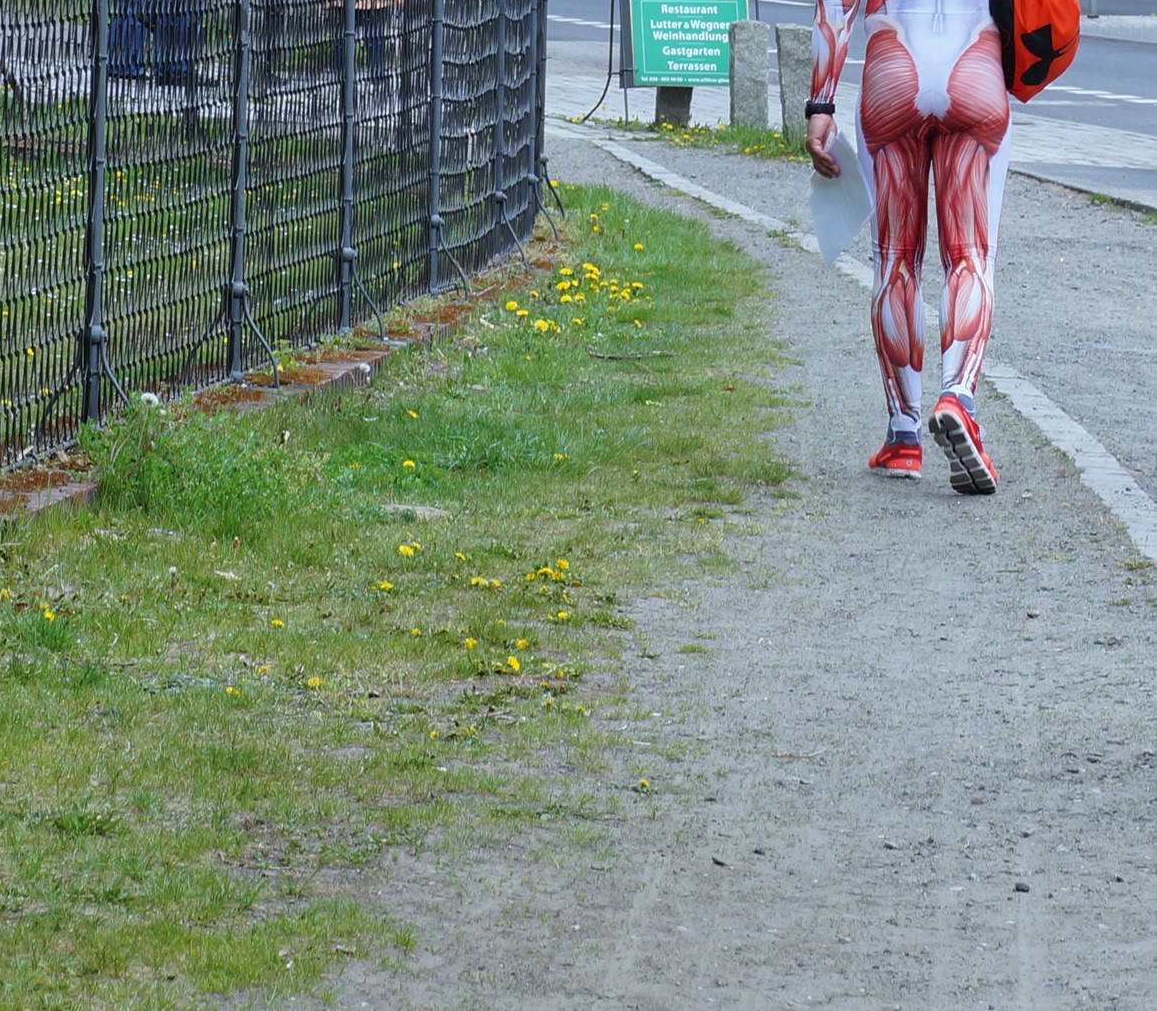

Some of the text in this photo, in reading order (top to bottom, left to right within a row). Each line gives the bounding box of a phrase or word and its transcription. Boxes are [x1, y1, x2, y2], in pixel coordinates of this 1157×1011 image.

[661, 4, 718, 14] Restaurant
[650, 19, 682, 29] Lutter
[690, 19, 730, 31] Wegner
[652, 31, 729, 43] Weinhandlung
[662, 46, 721, 58] Gastgarten
[667, 61, 717, 71] Terrassen
